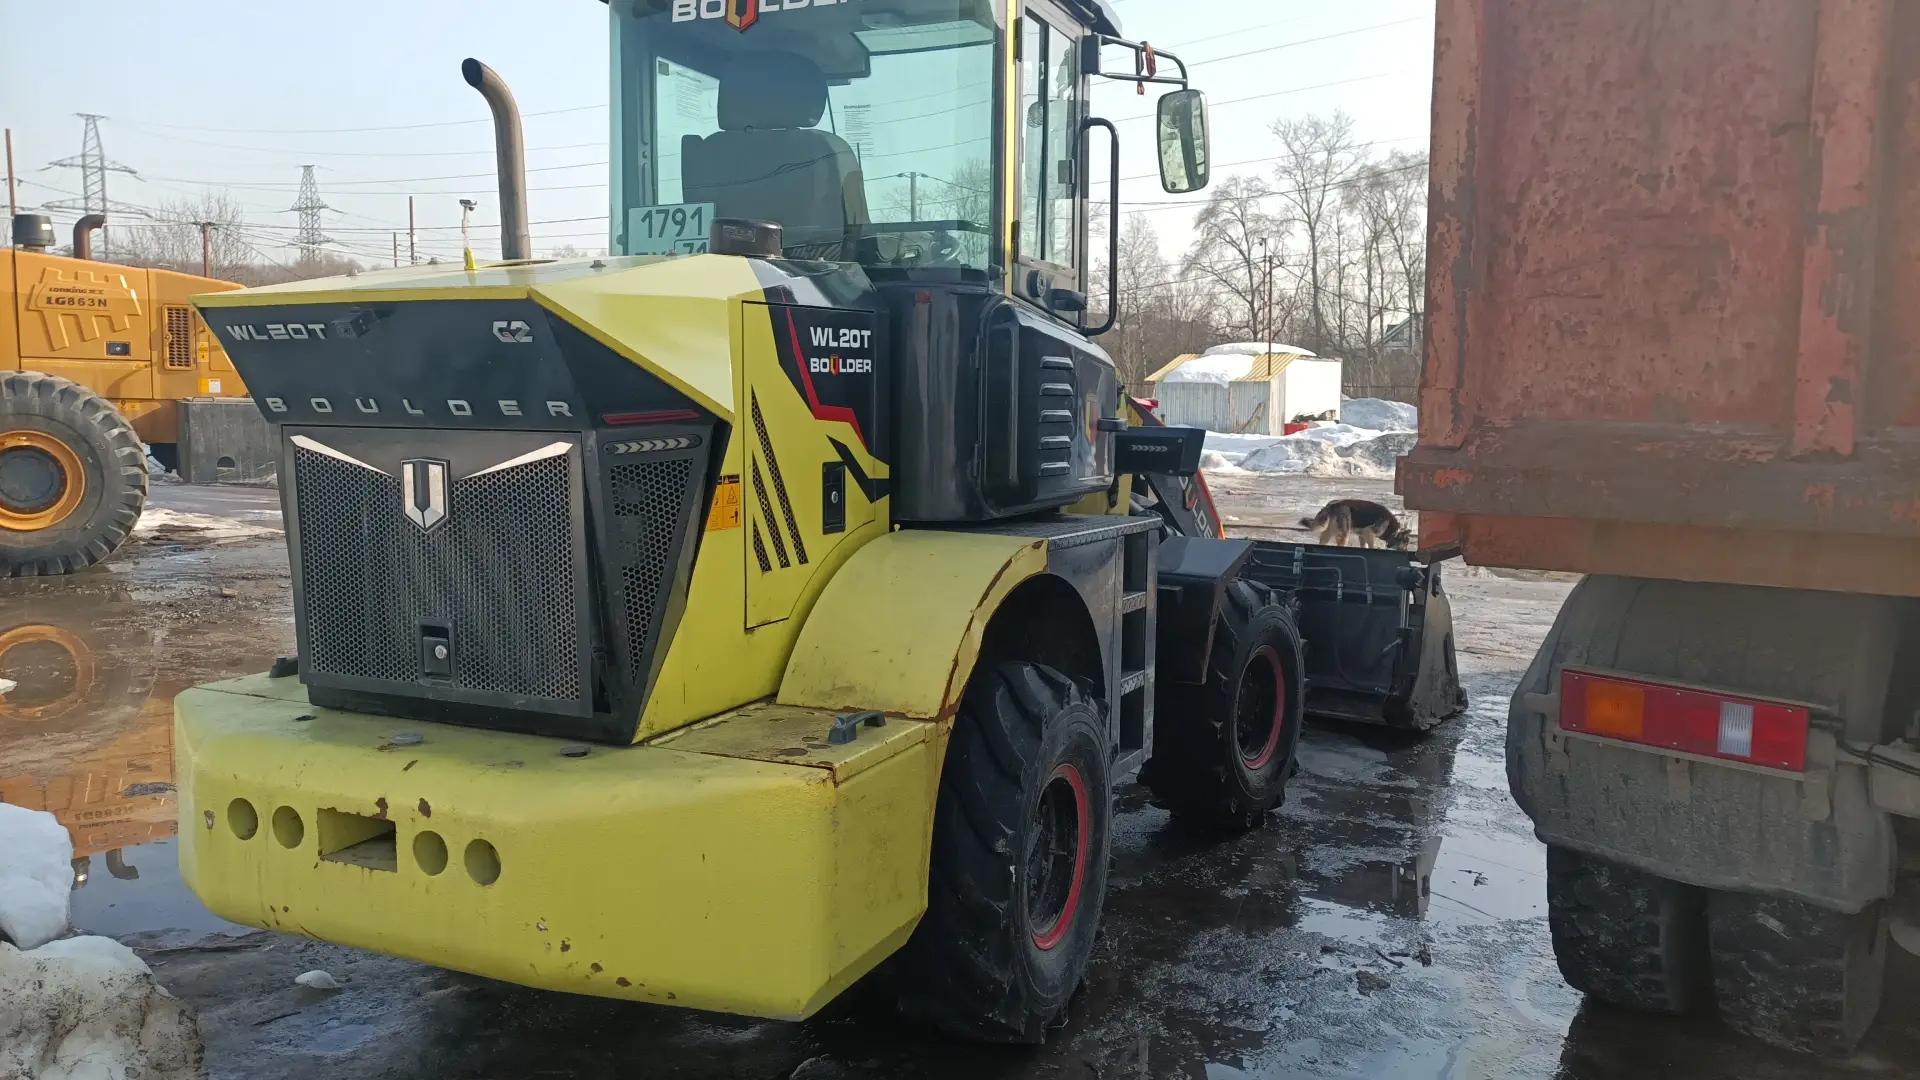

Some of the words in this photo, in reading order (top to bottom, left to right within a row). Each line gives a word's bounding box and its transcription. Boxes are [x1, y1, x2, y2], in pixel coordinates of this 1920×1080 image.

[641, 206, 703, 239] 1791
[46, 296, 107, 307] LG863N
[226, 323, 326, 341] WL20T
[809, 326, 872, 348] WL20T
[810, 354, 872, 376] BOULDER
[265, 397, 574, 417] BOULDER
